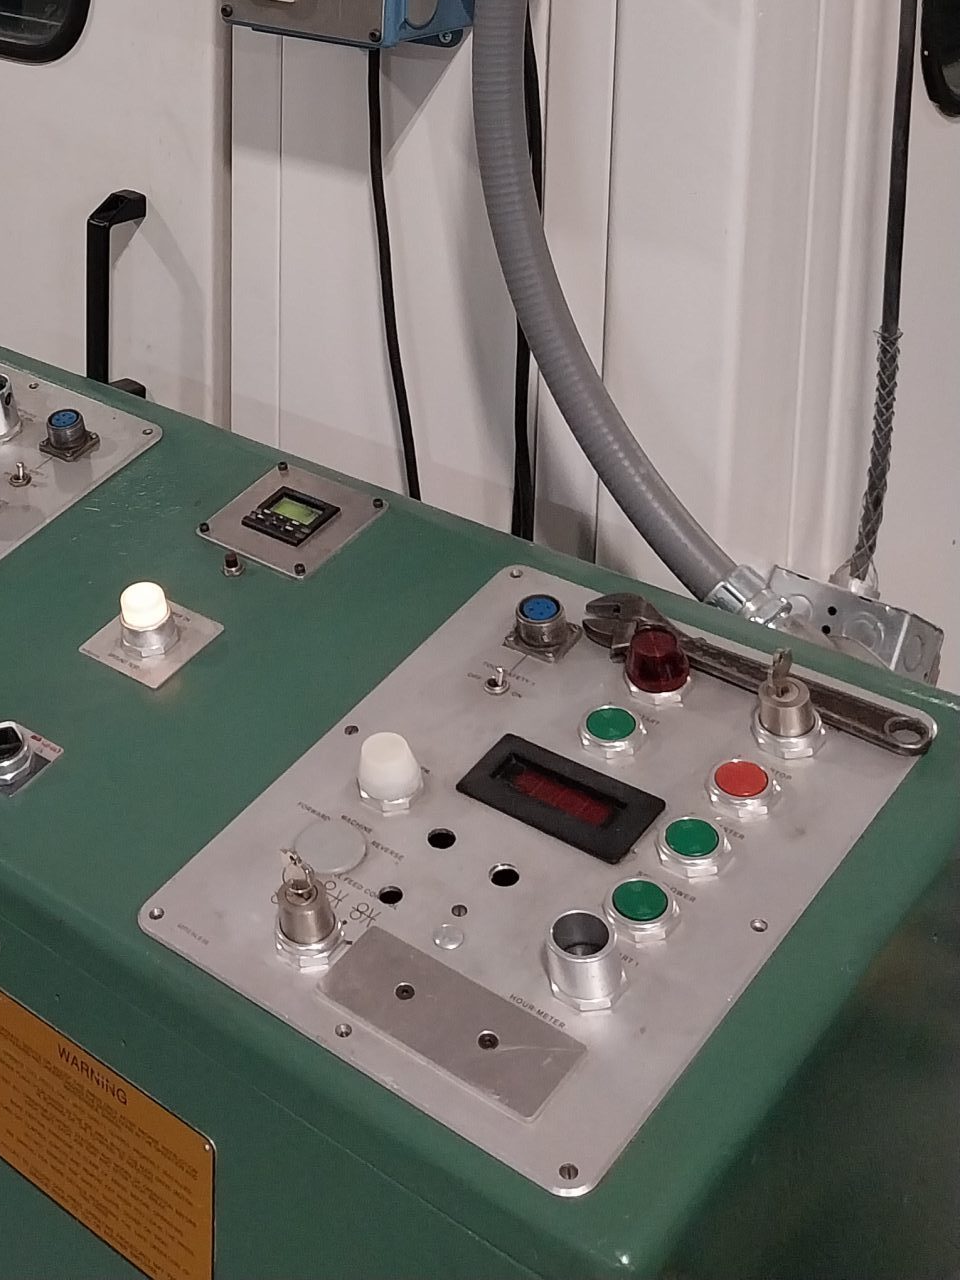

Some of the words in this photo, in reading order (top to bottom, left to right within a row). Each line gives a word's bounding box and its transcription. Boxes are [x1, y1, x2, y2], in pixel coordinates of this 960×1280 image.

[296, 801, 331, 821] FORWARD
[341, 814, 373, 834] MACHINE
[371, 840, 405, 862] REVERSE
[343, 876, 364, 891] FEED
[510, 993, 535, 1011] HOUR
[536, 1008, 566, 1029] METER
[57, 1042, 128, 1106] WARNING
